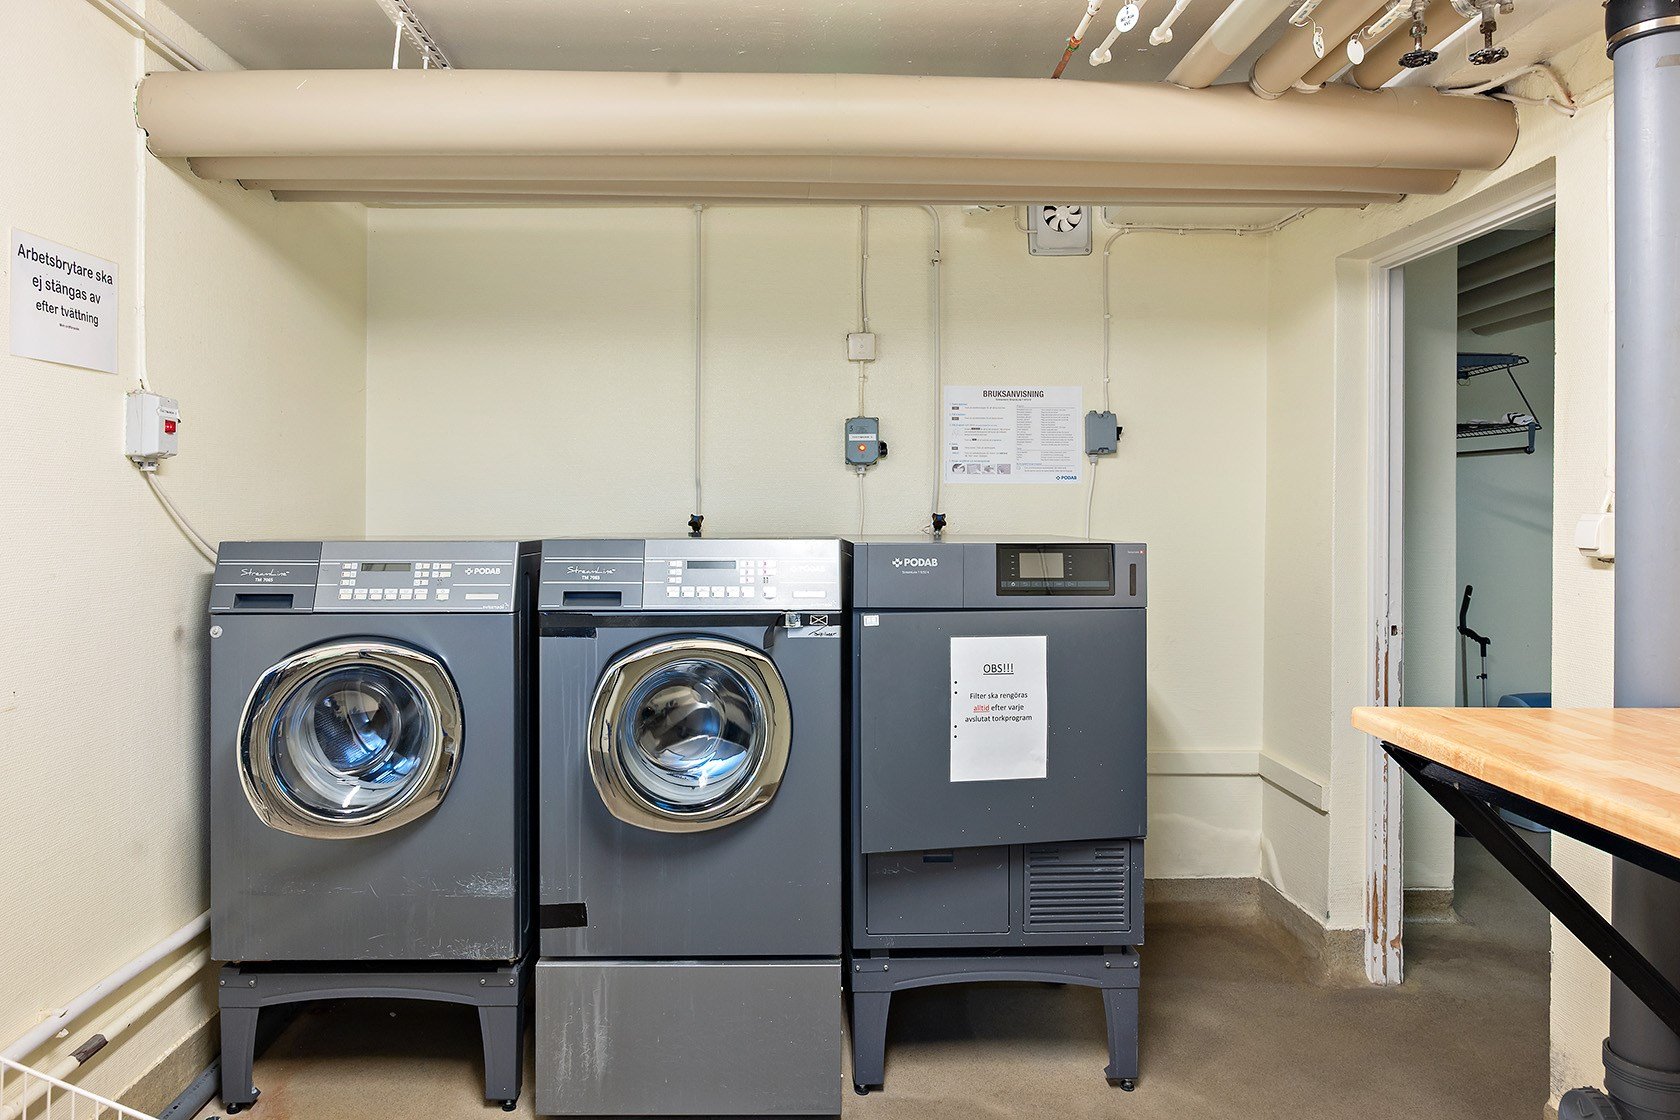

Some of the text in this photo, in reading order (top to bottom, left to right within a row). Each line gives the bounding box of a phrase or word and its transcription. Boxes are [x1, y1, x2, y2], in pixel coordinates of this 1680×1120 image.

[18, 243, 113, 285] Arbetsbrytare ska
[32, 275, 101, 304] ej stängas av
[36, 300, 58, 314] efter
[61, 305, 99, 327] tvättning
[982, 390, 1044, 398] BRUKSANVISNING
[904, 558, 938, 567] PODAB
[474, 567, 501, 575] PODAB
[983, 663, 1014, 674] OBS!!!
[999, 691, 1028, 700] rengöras
[973, 704, 990, 712] alltid
[1008, 704, 1024, 712] varje
[991, 714, 1033, 723] torkprogram
